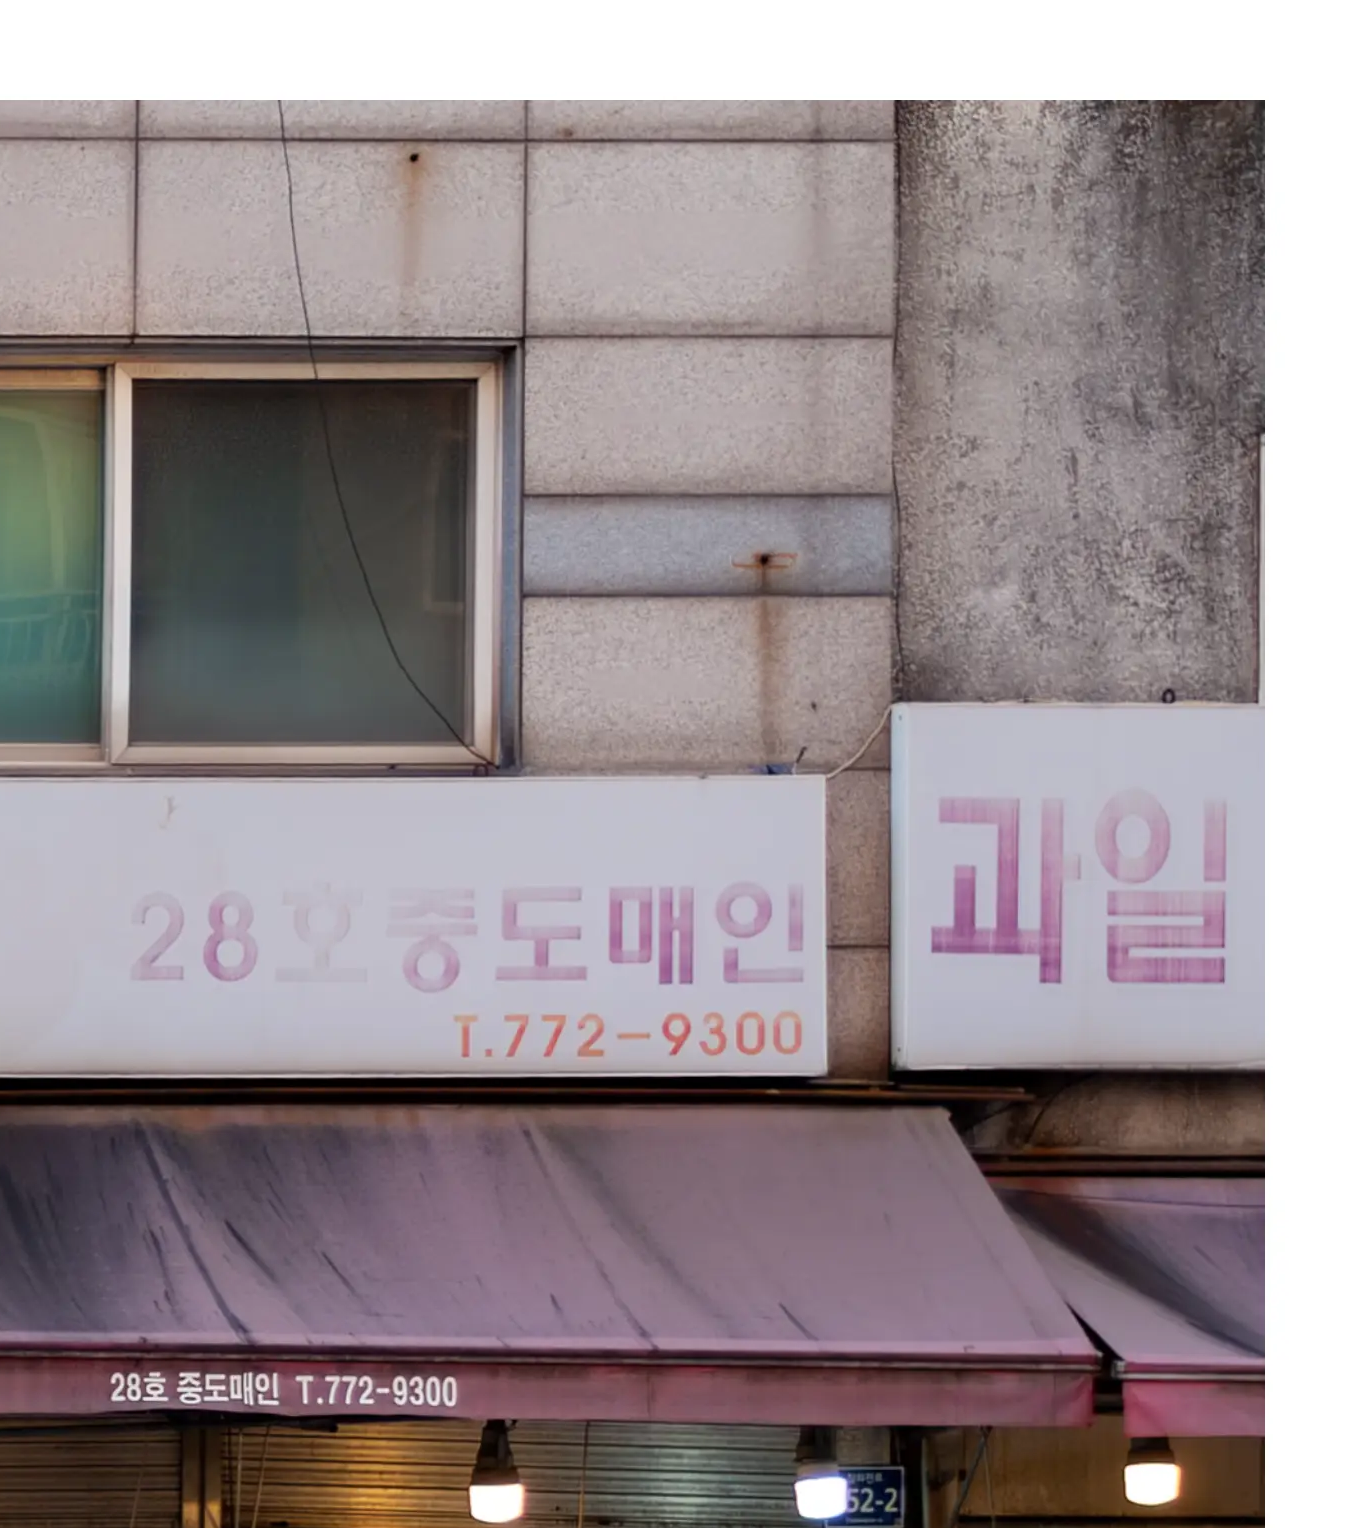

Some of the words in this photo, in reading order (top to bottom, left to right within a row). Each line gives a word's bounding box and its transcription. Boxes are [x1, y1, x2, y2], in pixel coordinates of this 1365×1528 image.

[930, 787, 1228, 985] 과일
[453, 1010, 803, 1059] T.772-9300
[110, 1371, 169, 1403] 28호
[176, 1371, 280, 1406] 중도매인
[295, 1375, 458, 1407] T.772-9300
[846, 1486, 899, 1514] 52-2
